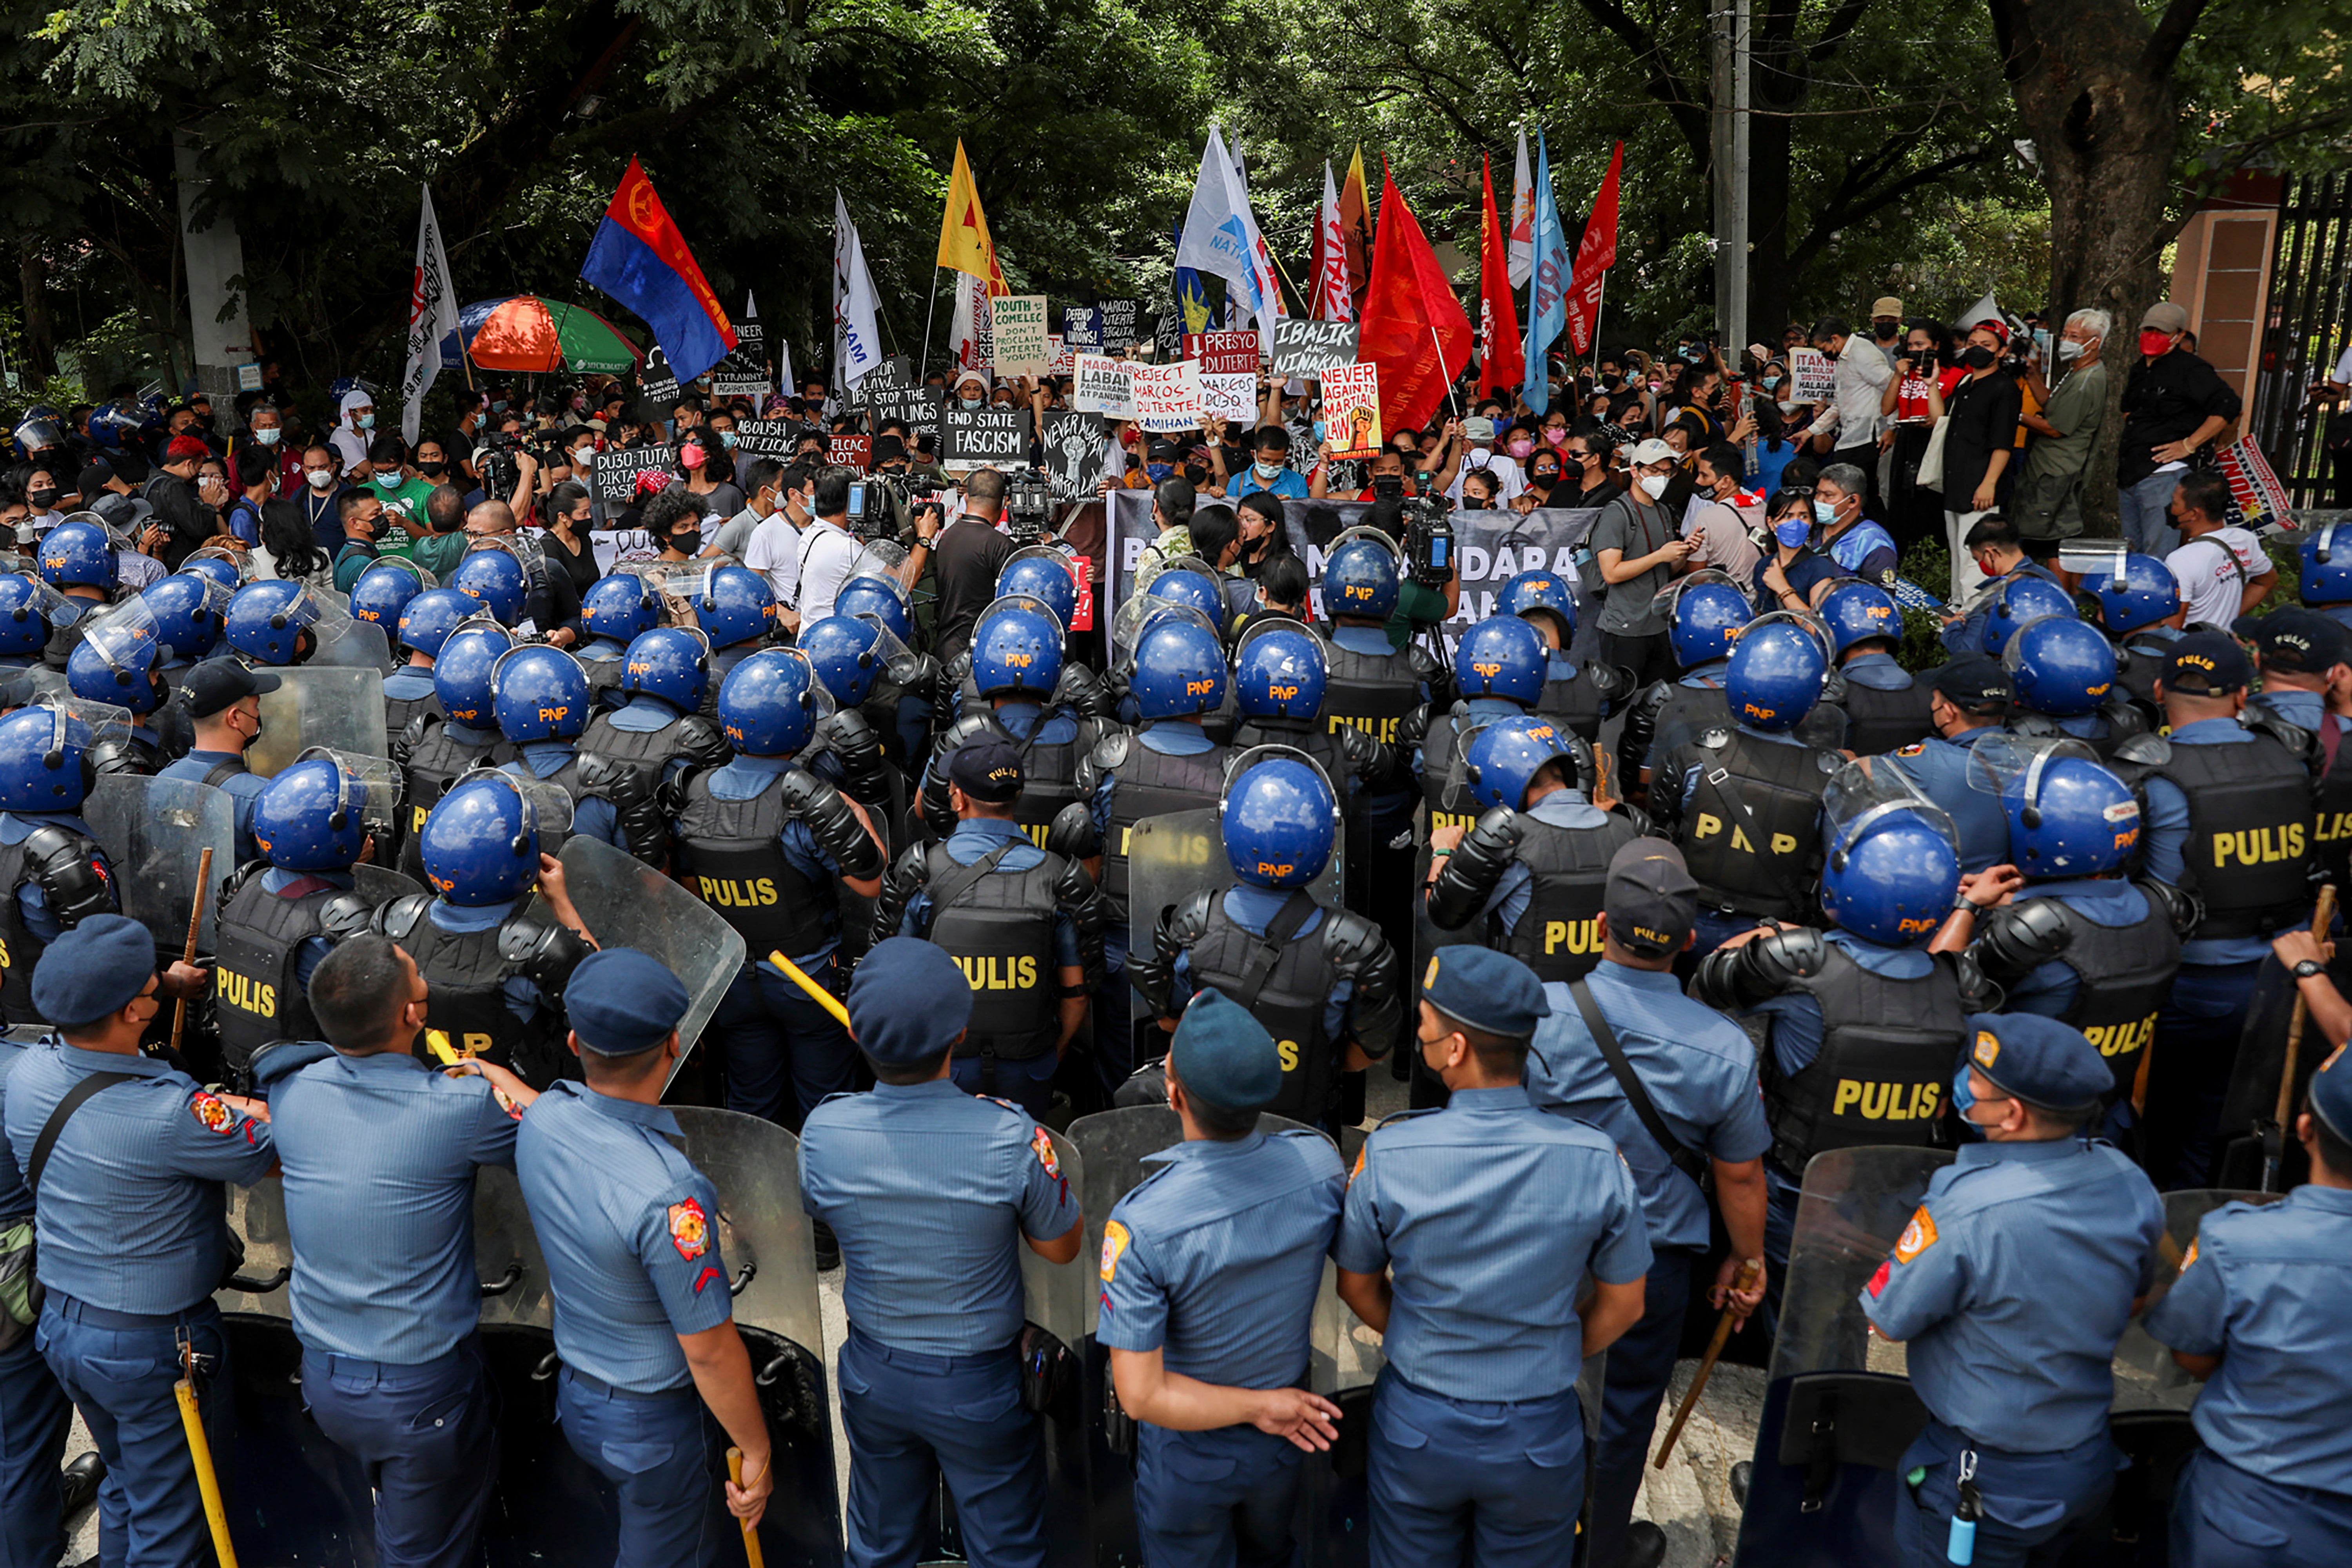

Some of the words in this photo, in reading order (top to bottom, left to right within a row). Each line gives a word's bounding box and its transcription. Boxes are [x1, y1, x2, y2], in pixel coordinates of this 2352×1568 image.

[995, 300, 1031, 313] YOUTH
[1065, 308, 1094, 322] DEFEND
[1099, 300, 1136, 314] MARCOS
[1005, 326, 1037, 335] DON'T
[1073, 321, 1087, 332] OUR
[1275, 320, 1356, 346] IBALIK
[996, 335, 1043, 346] PROCLAIM
[1205, 333, 1256, 352] PRESYO
[1304, 344, 1328, 353] ANG
[1000, 344, 1042, 355] DUTERTE
[587, 362, 629, 370] MICROMATIC
[1082, 359, 1134, 374] MAGKAIS
[1205, 354, 1256, 373] DUTERTE
[1796, 355, 1838, 368] ITAKW
[717, 372, 763, 382] TYRANNY
[1134, 366, 1185, 381] REJECT
[1321, 364, 1375, 384] NEVER
[652, 389, 680, 403] RESIST!
[718, 384, 744, 393] AGHAM
[746, 384, 768, 392] YOUTH
[874, 392, 900, 405] STOP
[905, 388, 926, 402] THE
[1092, 392, 1131, 402] PANUNUP
[1323, 384, 1361, 402] AGAIN
[1364, 384, 1376, 395] TO
[1137, 393, 1201, 413] DUTERTE!
[1325, 393, 1376, 421] MARTIAL
[947, 411, 972, 426] END
[976, 413, 1016, 428] STATE
[1326, 414, 1349, 440] LAW
[737, 420, 786, 437] ABOLISH
[1042, 414, 1079, 453] NEVER
[955, 430, 1021, 454] FASCISM
[2217, 448, 2262, 511] MUNA
[45, 557, 67, 569] PNP
[1345, 585, 1374, 600] PNP
[1524, 580, 1551, 592] PNP
[358, 608, 380, 622] PNP
[1866, 607, 1892, 619] PNP
[2274, 633, 2311, 651] PULIS
[628, 662, 650, 674] PNP
[1005, 652, 1033, 669] PNP
[2176, 653, 2216, 671] PULIS
[1472, 662, 1502, 678] PNP
[1187, 679, 1215, 696] PNP
[1269, 685, 1299, 701] PNP
[453, 710, 478, 720] PNP
[539, 706, 568, 723] PNP
[1744, 703, 1776, 720] PNP
[1526, 725, 1554, 743] PNP
[988, 767, 1018, 781] PULIS
[2314, 812, 2352, 841] LIS
[2113, 827, 2140, 850] PNP
[2213, 823, 2305, 868] PULIS
[1257, 862, 1294, 877] PNP
[428, 872, 455, 892] PNP
[699, 876, 778, 906] PULIS
[1898, 918, 1938, 934] PNP
[1544, 919, 1605, 955] PUL
[1633, 926, 1670, 944] PULIS
[951, 955, 1037, 990] ULIS
[217, 966, 276, 1018] PULIS
[2083, 1011, 2158, 1057] PULIS
[1833, 1079, 1940, 1120] PULIS
